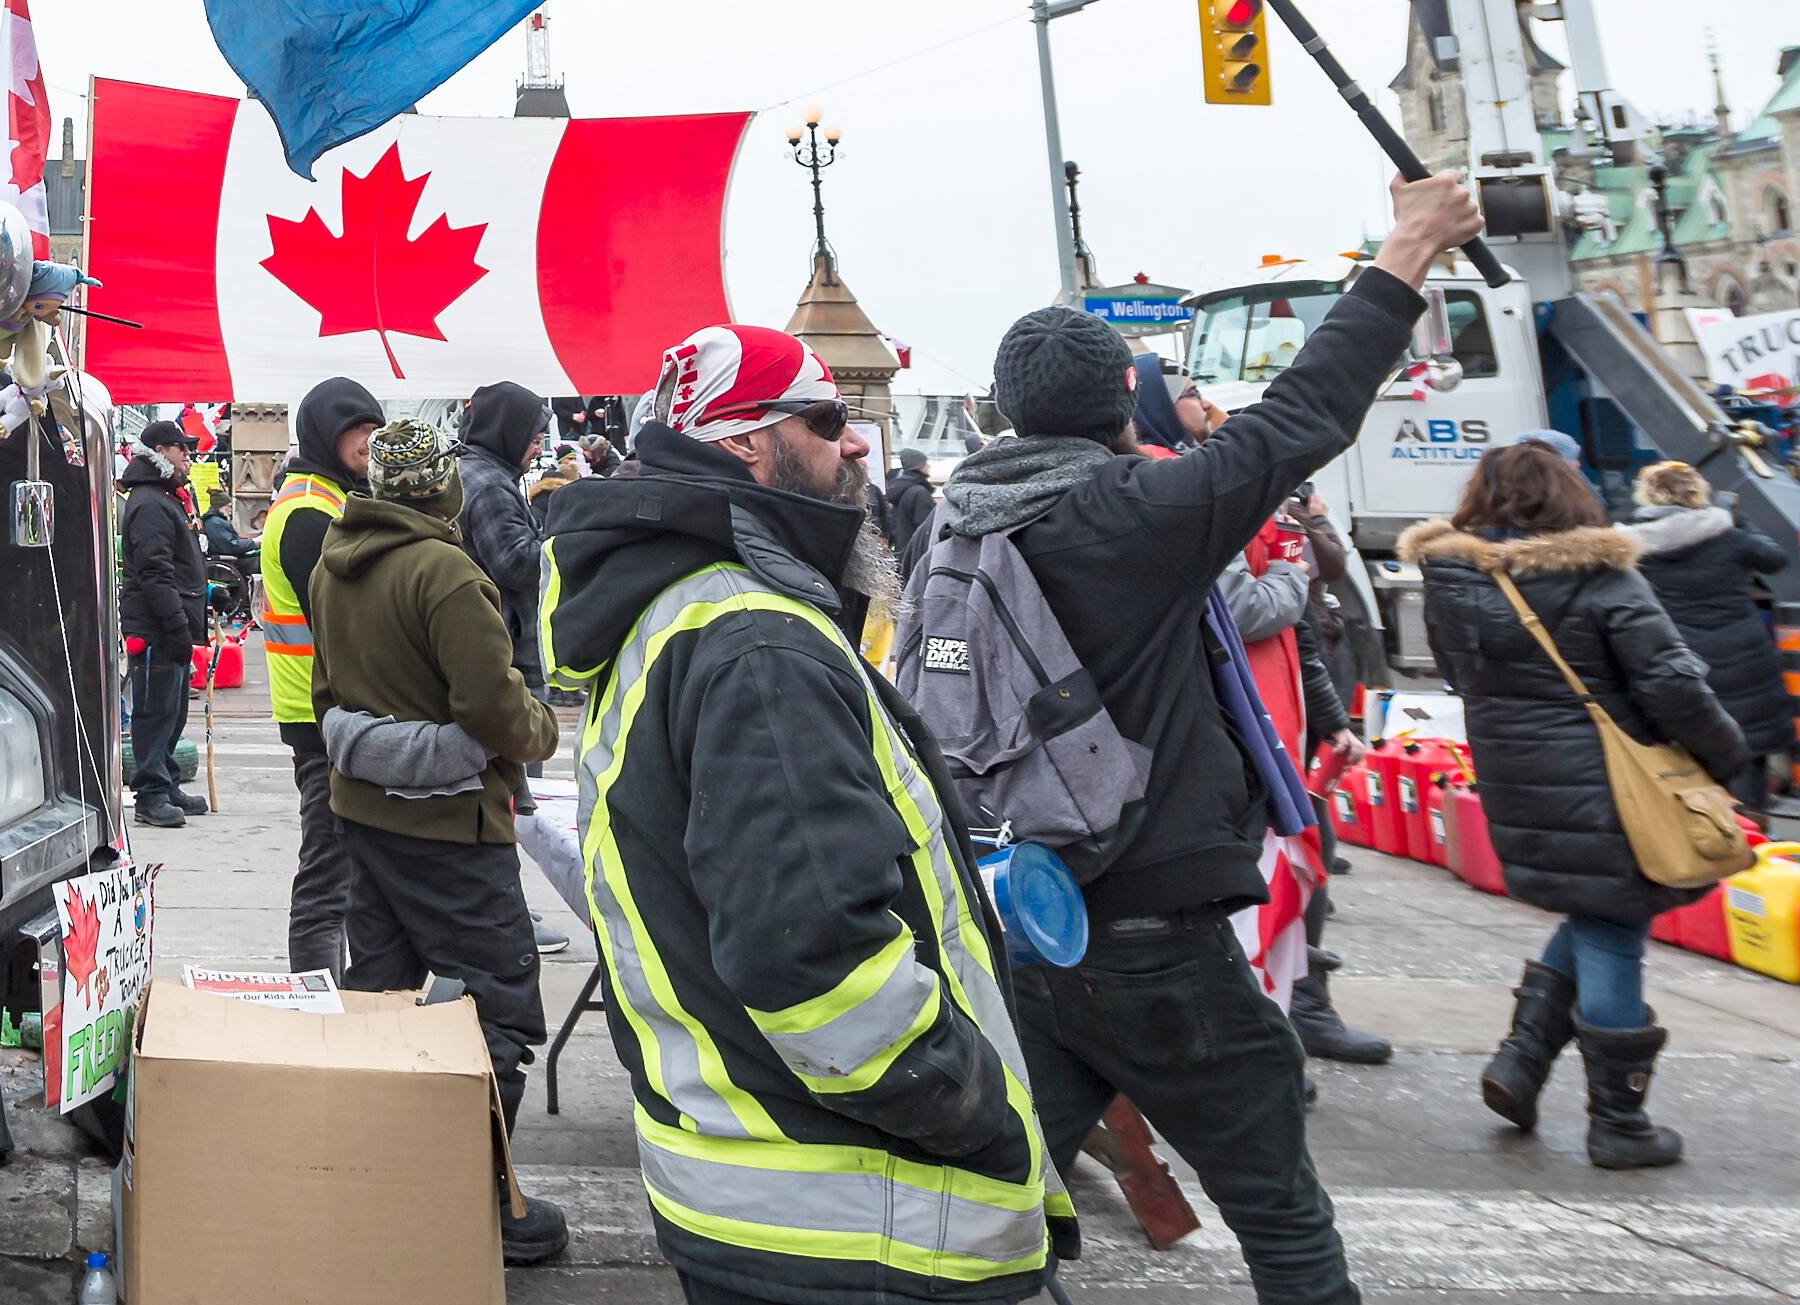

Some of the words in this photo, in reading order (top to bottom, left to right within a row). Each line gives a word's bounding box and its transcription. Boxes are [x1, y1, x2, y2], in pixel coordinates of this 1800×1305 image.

[1111, 301, 1184, 320] Wellington
[1394, 418, 1491, 443] ABS
[1391, 447, 1484, 459] ALTITUD
[926, 638, 968, 653] SUPE
[99, 873, 116, 911] Did
[117, 869, 130, 907] You
[114, 908, 122, 937] A
[106, 933, 146, 980] TRUCKER
[243, 993, 261, 1001] Our
